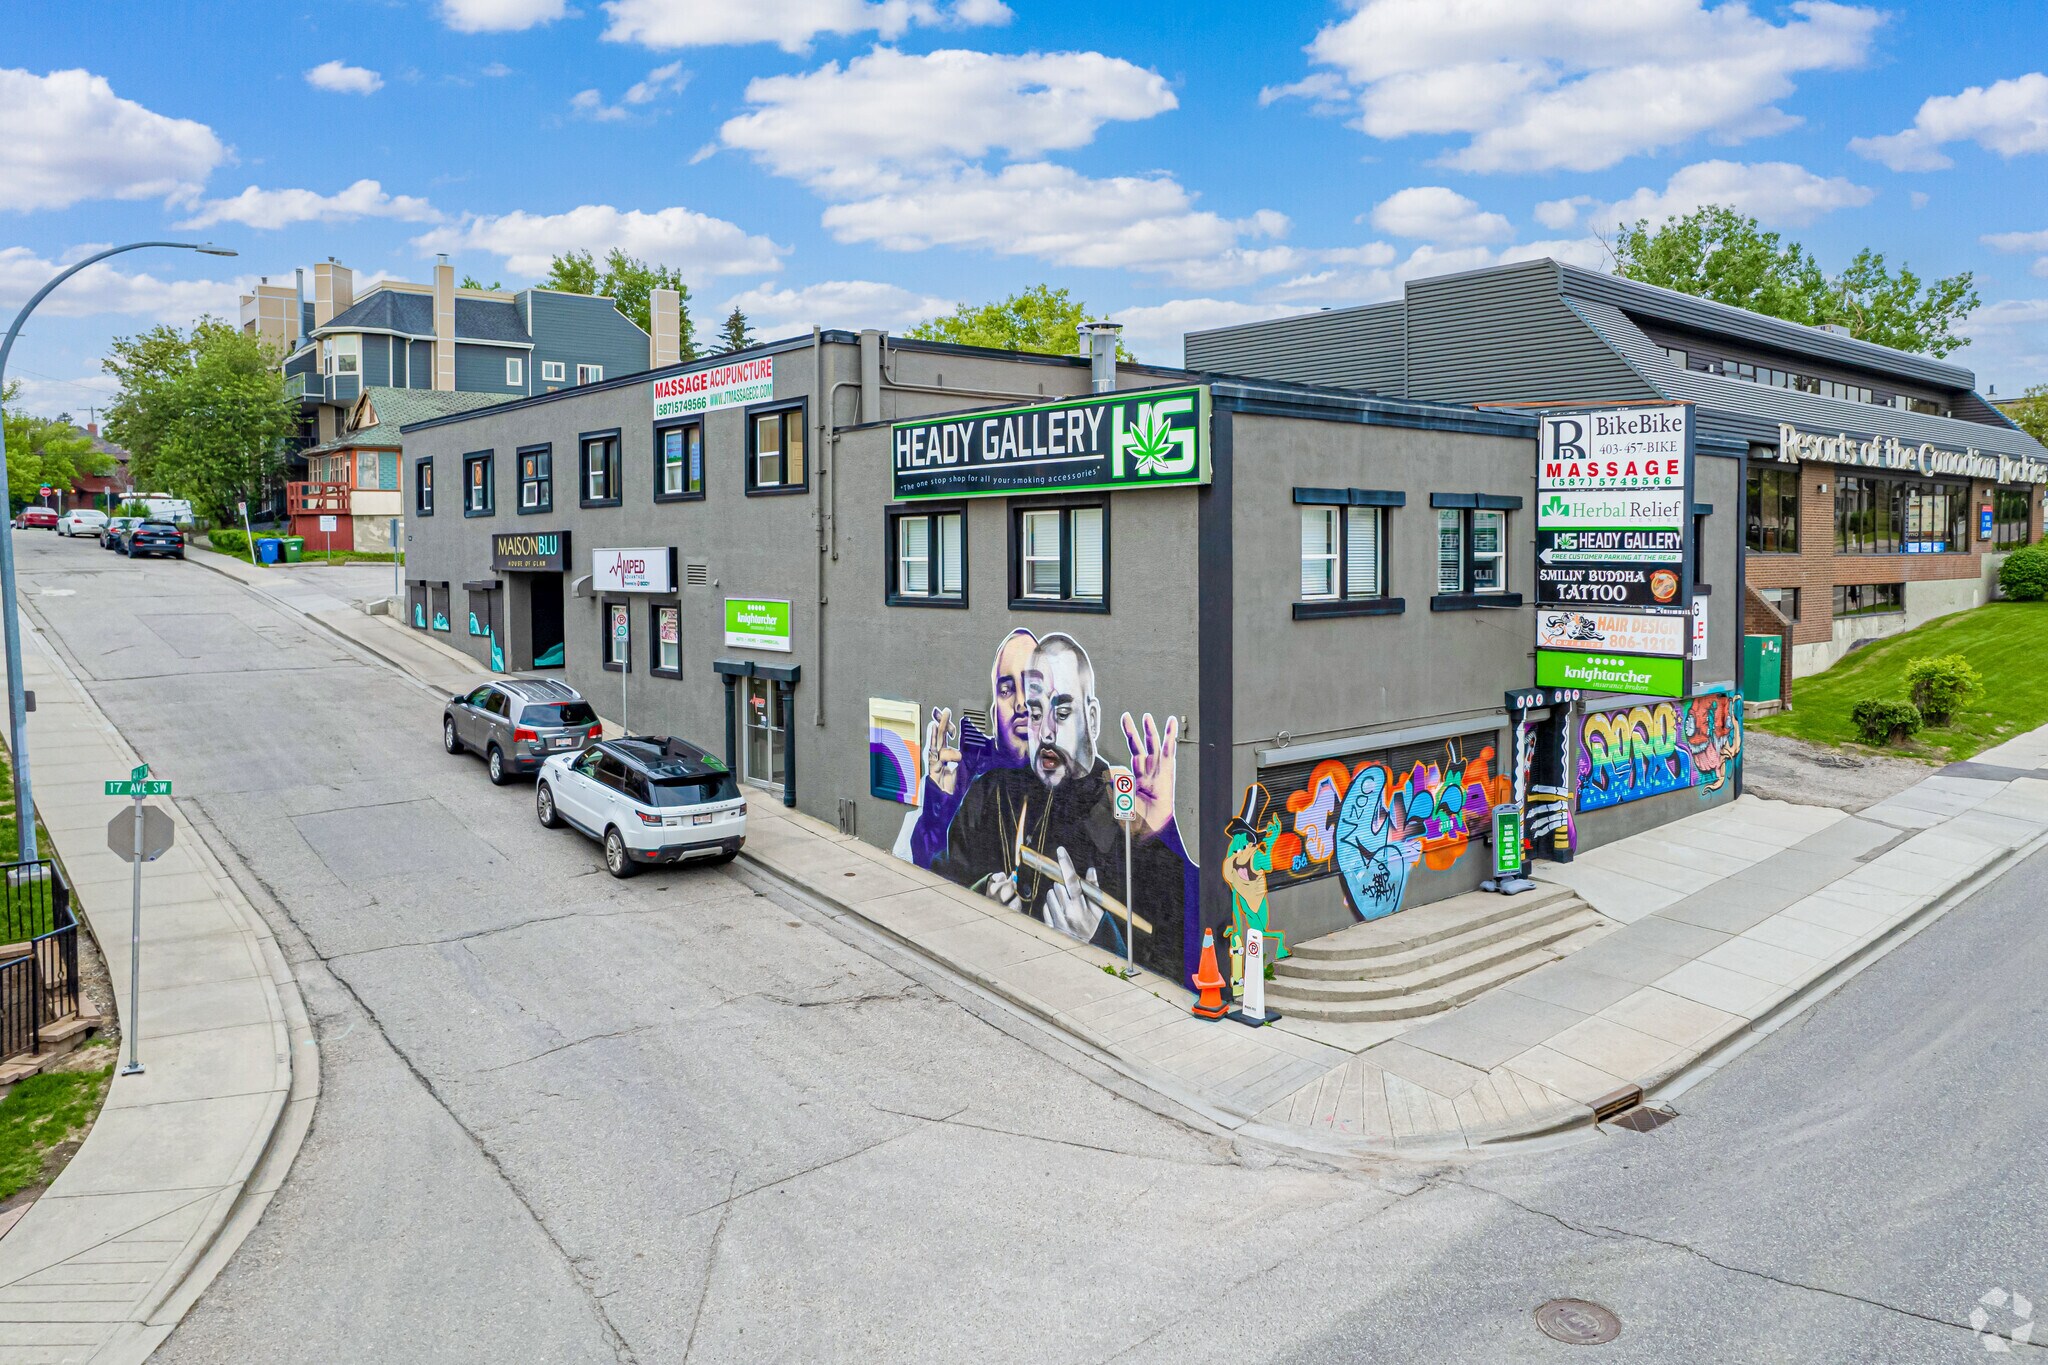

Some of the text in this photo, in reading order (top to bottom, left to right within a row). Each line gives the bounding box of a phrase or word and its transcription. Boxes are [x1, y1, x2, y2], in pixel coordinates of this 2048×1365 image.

[655, 358, 772, 399] MASSAGE ACUPUNCTURE
[656, 397, 707, 417] (587)5749566
[1596, 413, 1682, 436] BikeBike
[896, 406, 1105, 468] HEADY GALLERY
[1112, 396, 1196, 479] HG
[1599, 441, 1678, 455] 403-457-BIKE
[1777, 422, 2047, 485] Resorts of the Canadian Rockies
[1546, 460, 1679, 478] MASSAGE
[916, 480, 928, 488] one
[930, 477, 947, 485] stop
[949, 475, 966, 483] shop
[967, 474, 978, 482] for
[980, 475, 991, 483] all
[1012, 476, 1045, 485] smoking
[1572, 501, 1681, 518] Herbal Relief
[1579, 532, 1622, 549] HEADY
[1624, 532, 1682, 549] GALLERY
[1539, 569, 1646, 583] SMILIN' BUDDHA
[1556, 584, 1627, 601] TATTOO
[1597, 616, 1629, 633] HAIR
[1632, 617, 1680, 635] DESIGN
[1609, 635, 1675, 651] 806-1212
[1564, 666, 1652, 685] knightarcher
[1592, 682, 1649, 691] insurance brokers
[109, 782, 168, 793] 17 AVE SW
